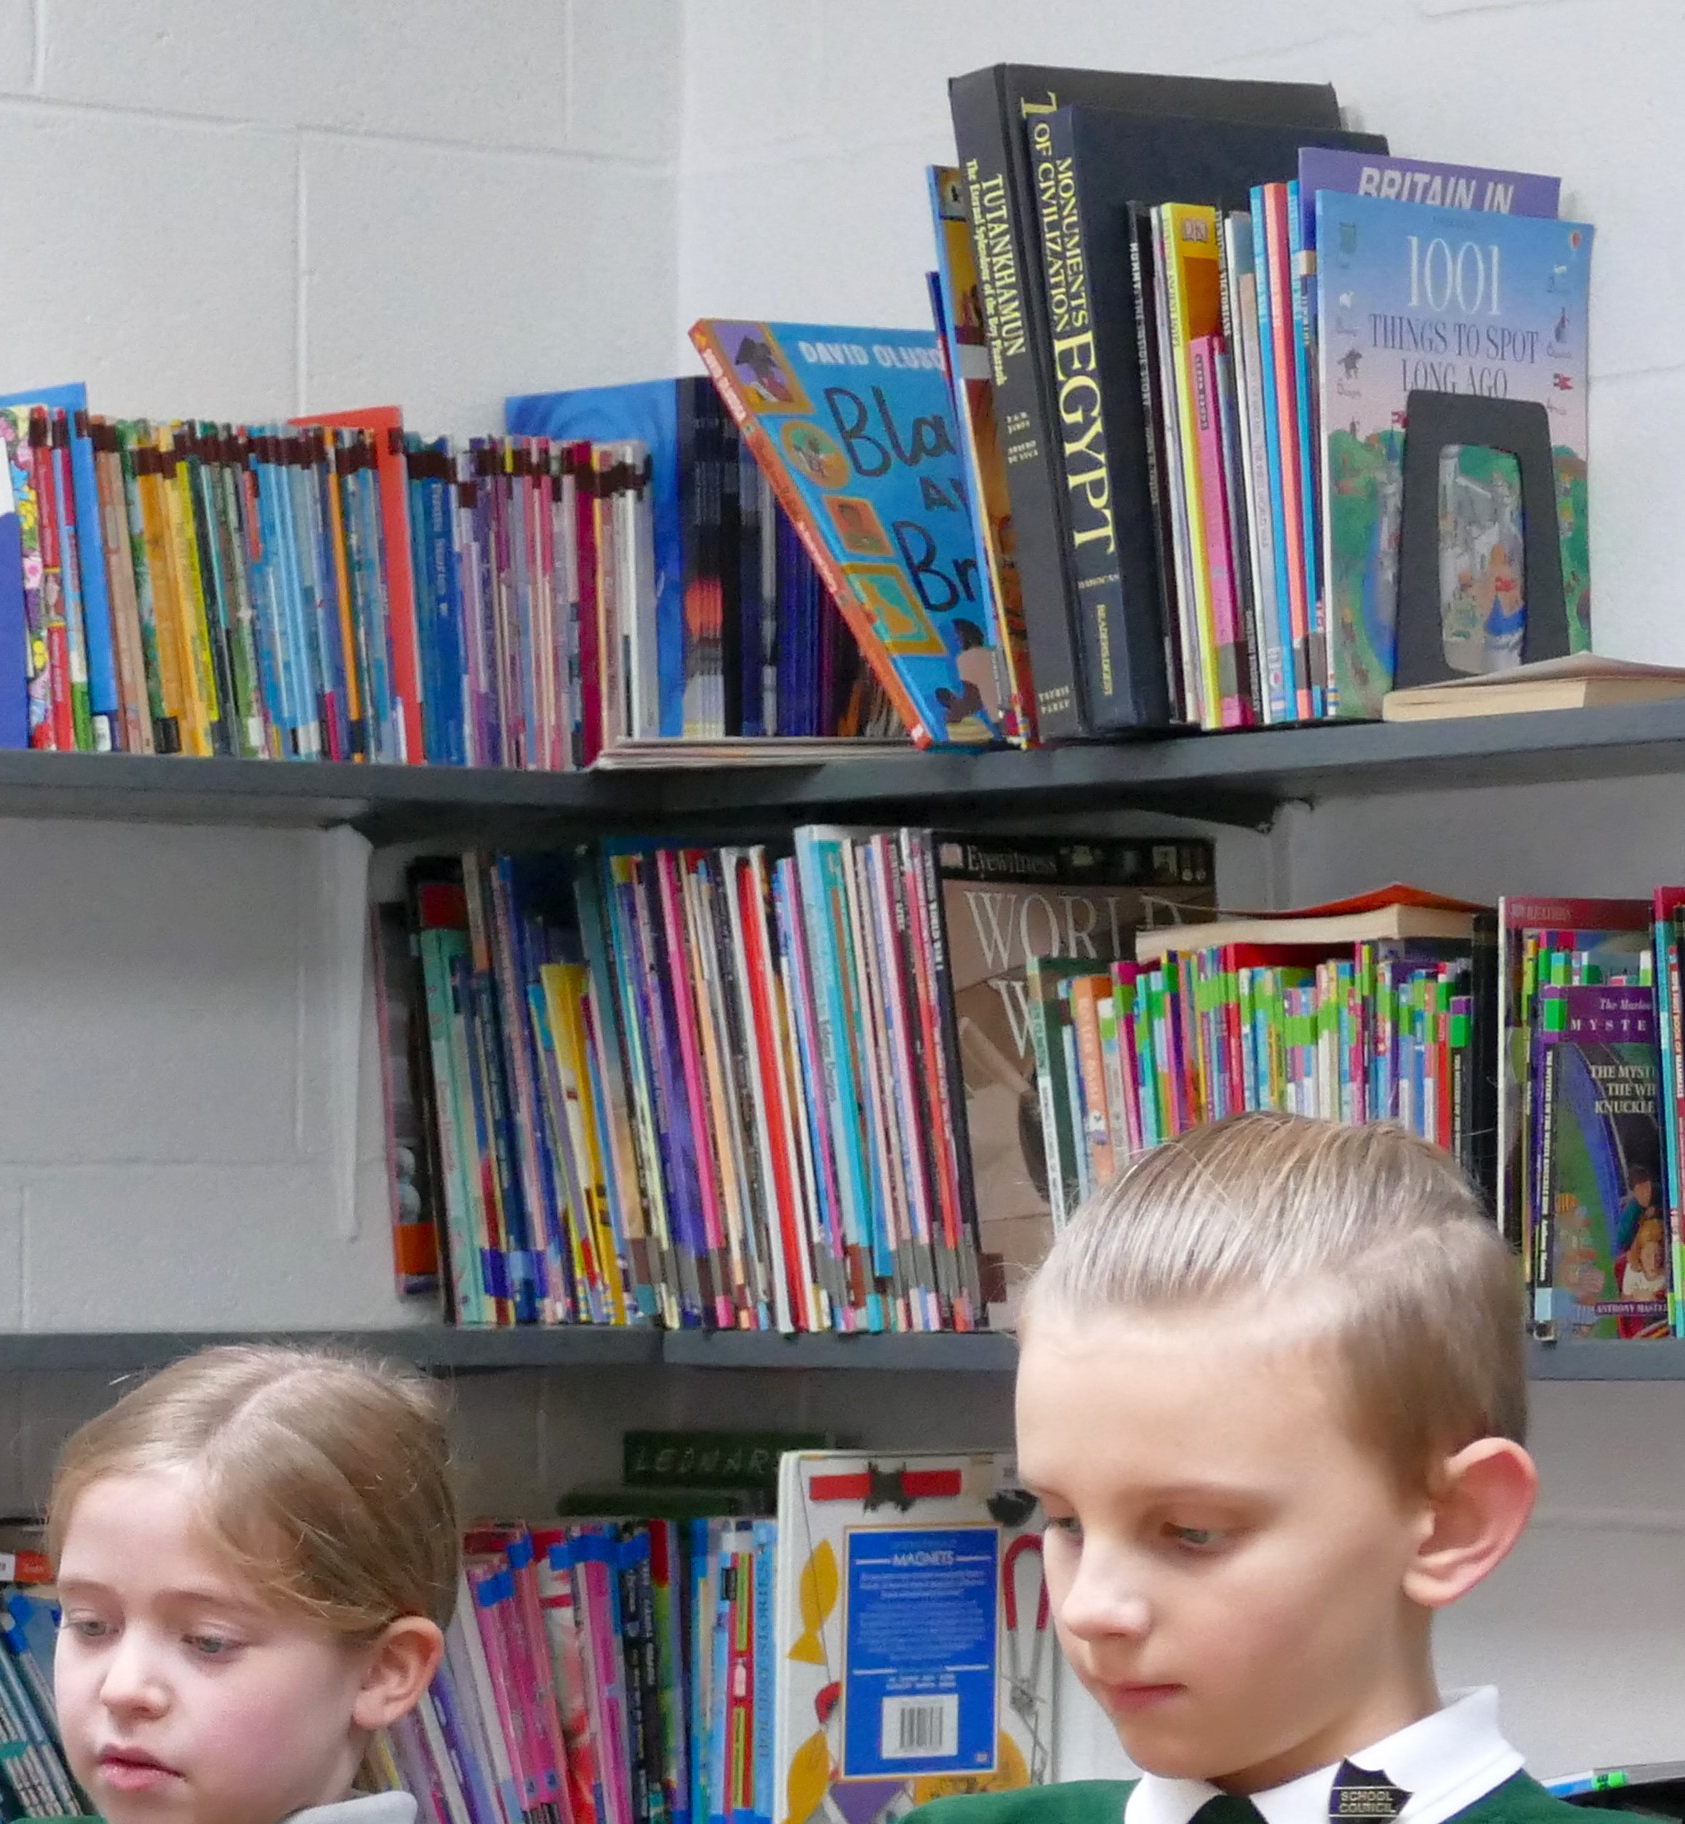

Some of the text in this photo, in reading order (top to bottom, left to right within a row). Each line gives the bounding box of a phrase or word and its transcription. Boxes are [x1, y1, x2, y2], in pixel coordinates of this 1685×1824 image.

[1033, 123, 1070, 332] OF CIVILIZATION
[1359, 167, 1514, 214] BRITAIN IN
[982, 174, 1025, 356] TUTANKHAMUN
[1056, 157, 1088, 327] MONUMENTS
[1408, 235, 1501, 315] 1001
[798, 341, 870, 365] DAVID
[1369, 313, 1538, 363] THINGS TO SPOT
[1402, 359, 1507, 398] LONG AGO
[1052, 329, 1118, 554] EGYPT
